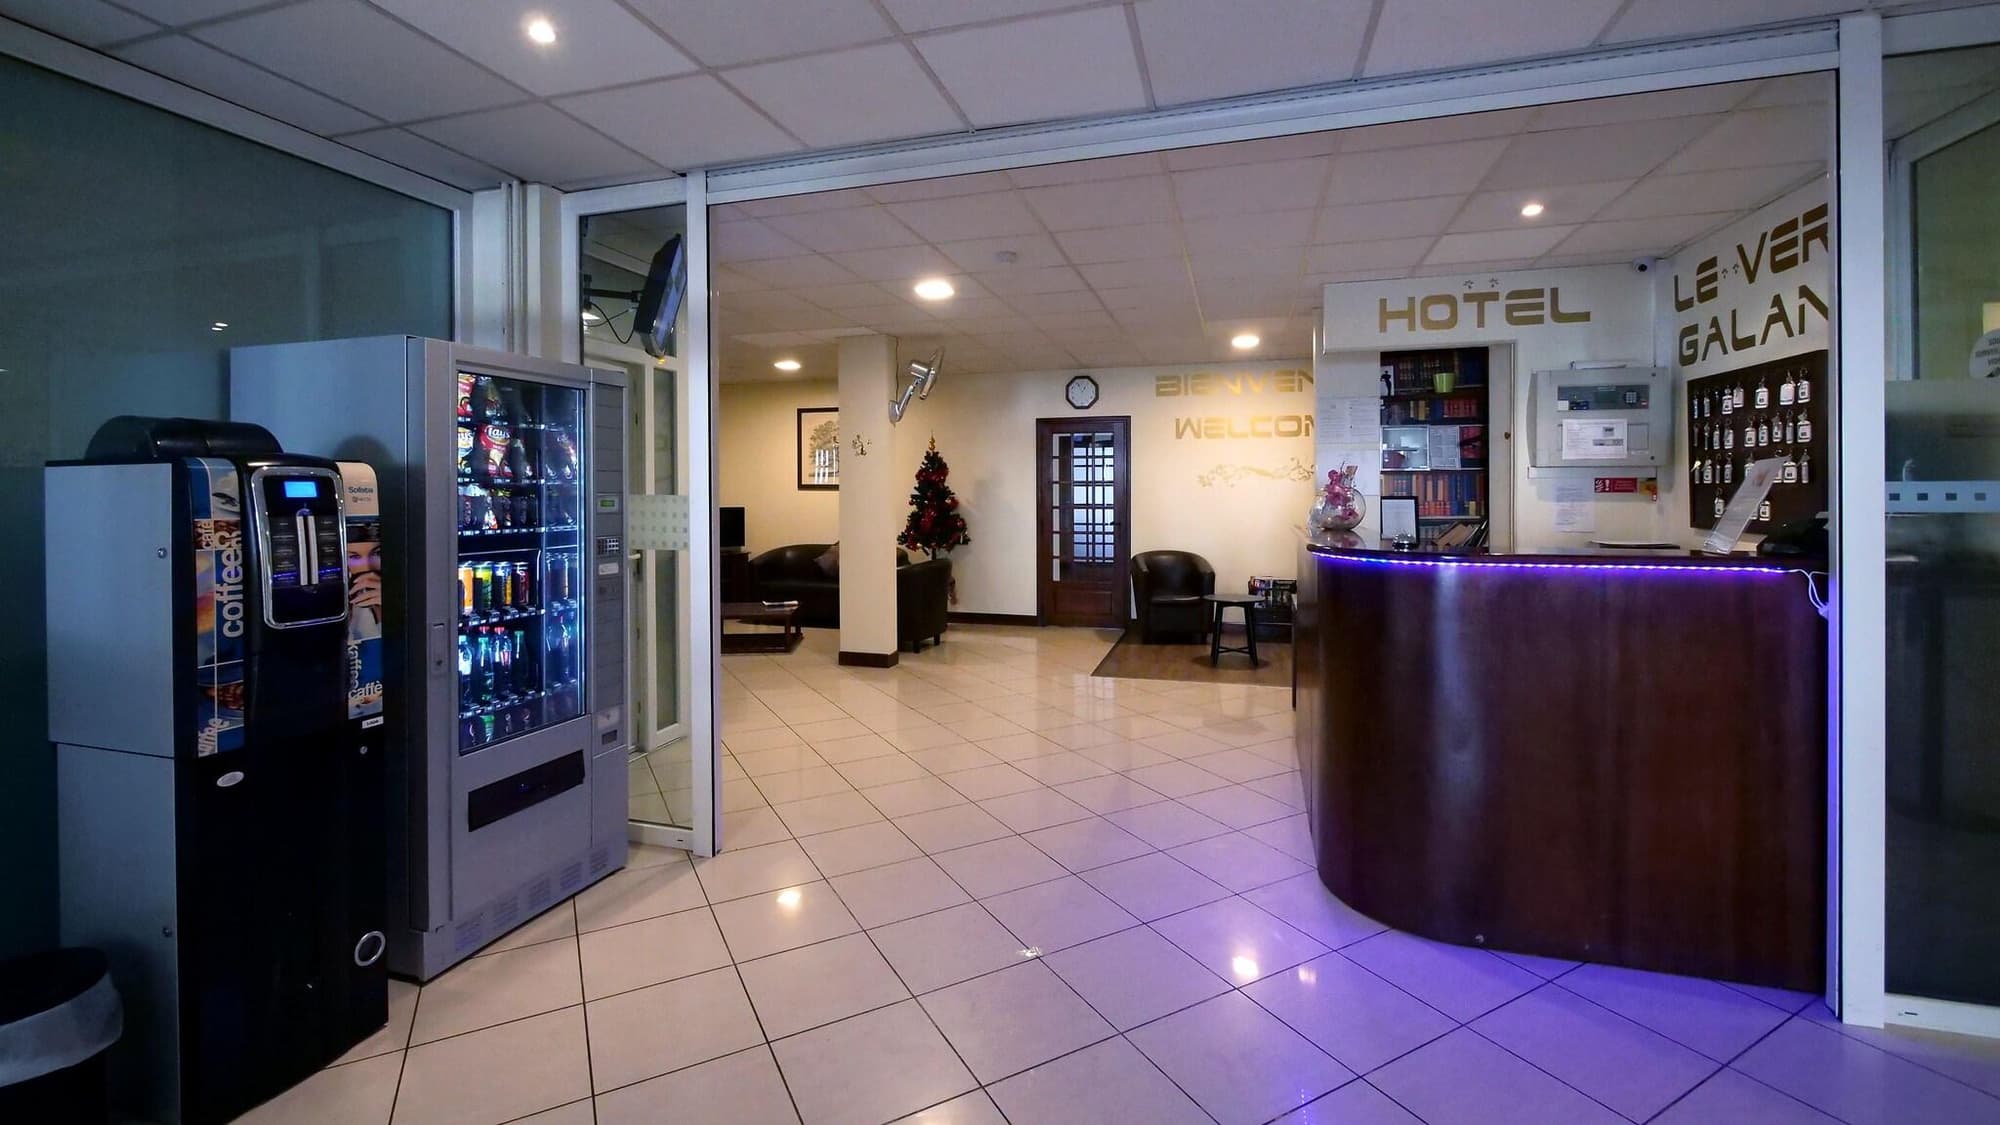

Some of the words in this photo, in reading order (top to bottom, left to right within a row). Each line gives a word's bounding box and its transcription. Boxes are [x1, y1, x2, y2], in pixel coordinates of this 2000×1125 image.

[1674, 256, 1718, 312] LE
[1736, 203, 1828, 284] VER
[1379, 287, 1591, 333] HOTEL
[1175, 414, 1314, 440] WELCO
[216, 549, 243, 638] coffee
